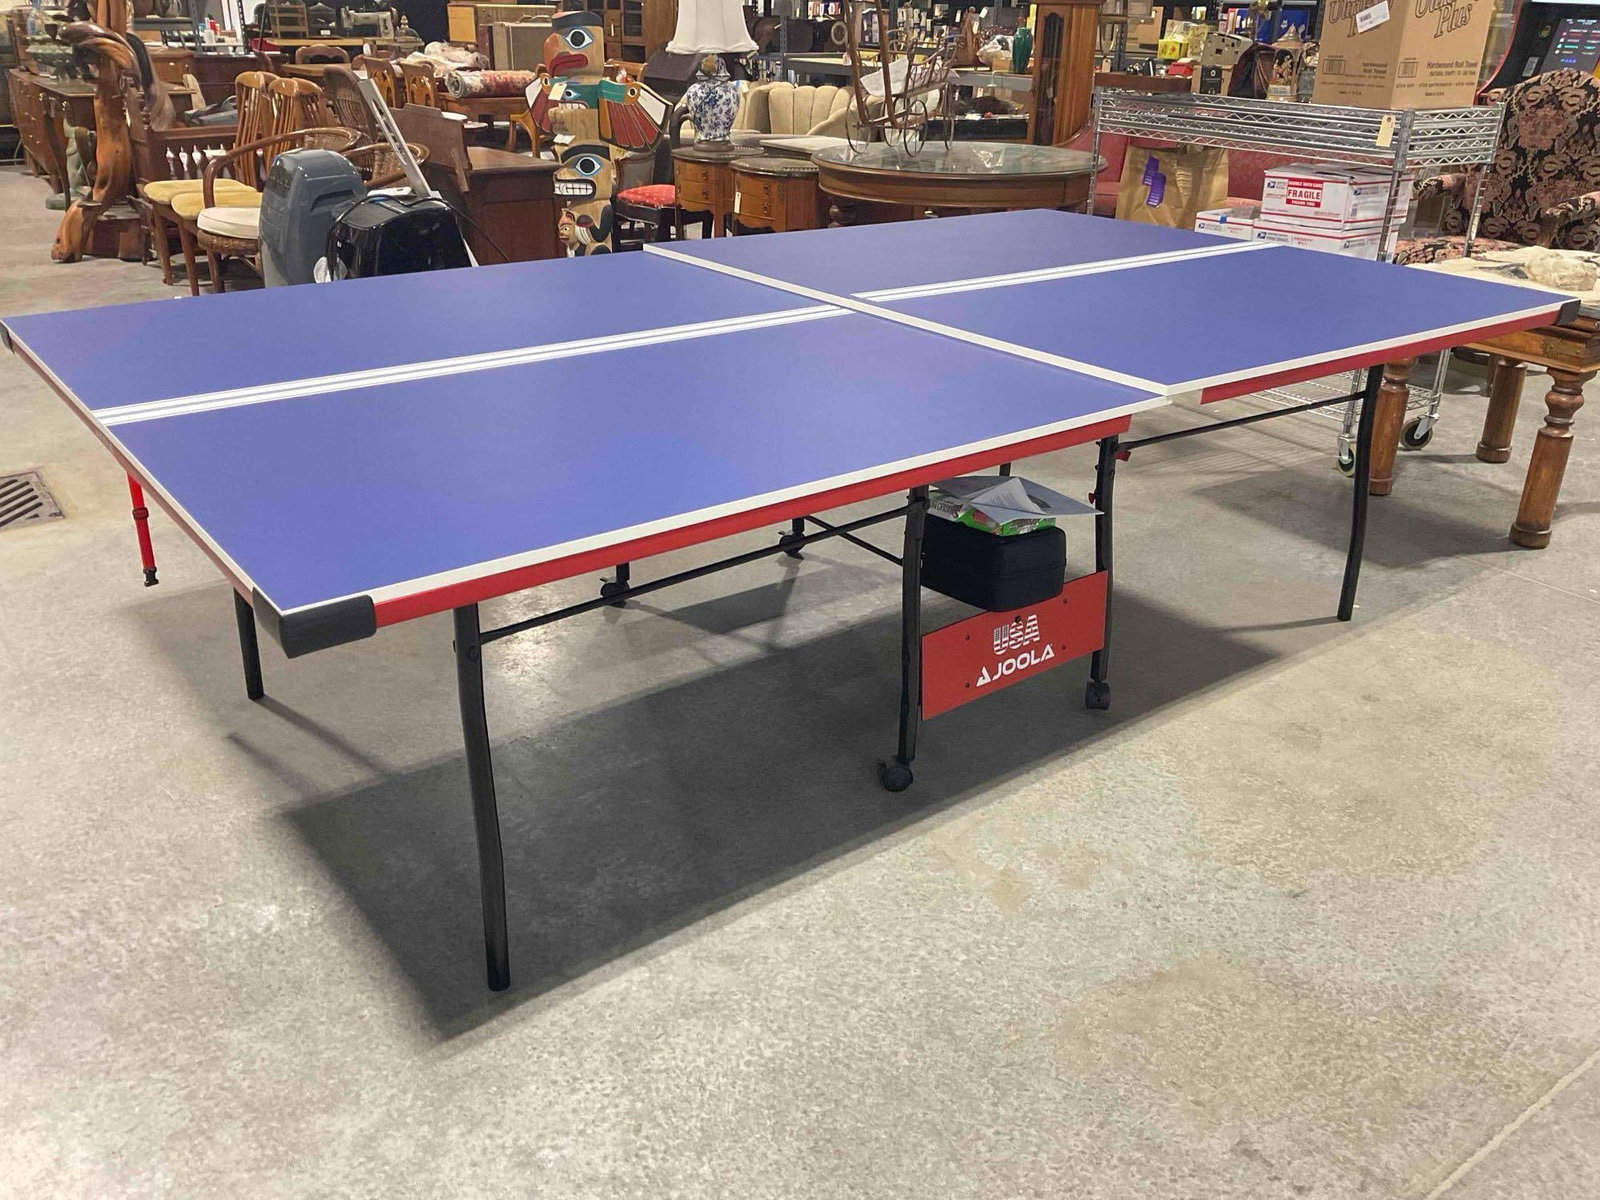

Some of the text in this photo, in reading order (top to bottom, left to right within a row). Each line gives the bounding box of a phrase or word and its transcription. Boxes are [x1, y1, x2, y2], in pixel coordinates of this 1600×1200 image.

[1434, 3, 1473, 39] Plus
[1287, 189, 1322, 200] FRAGILE
[993, 614, 1040, 655] USA
